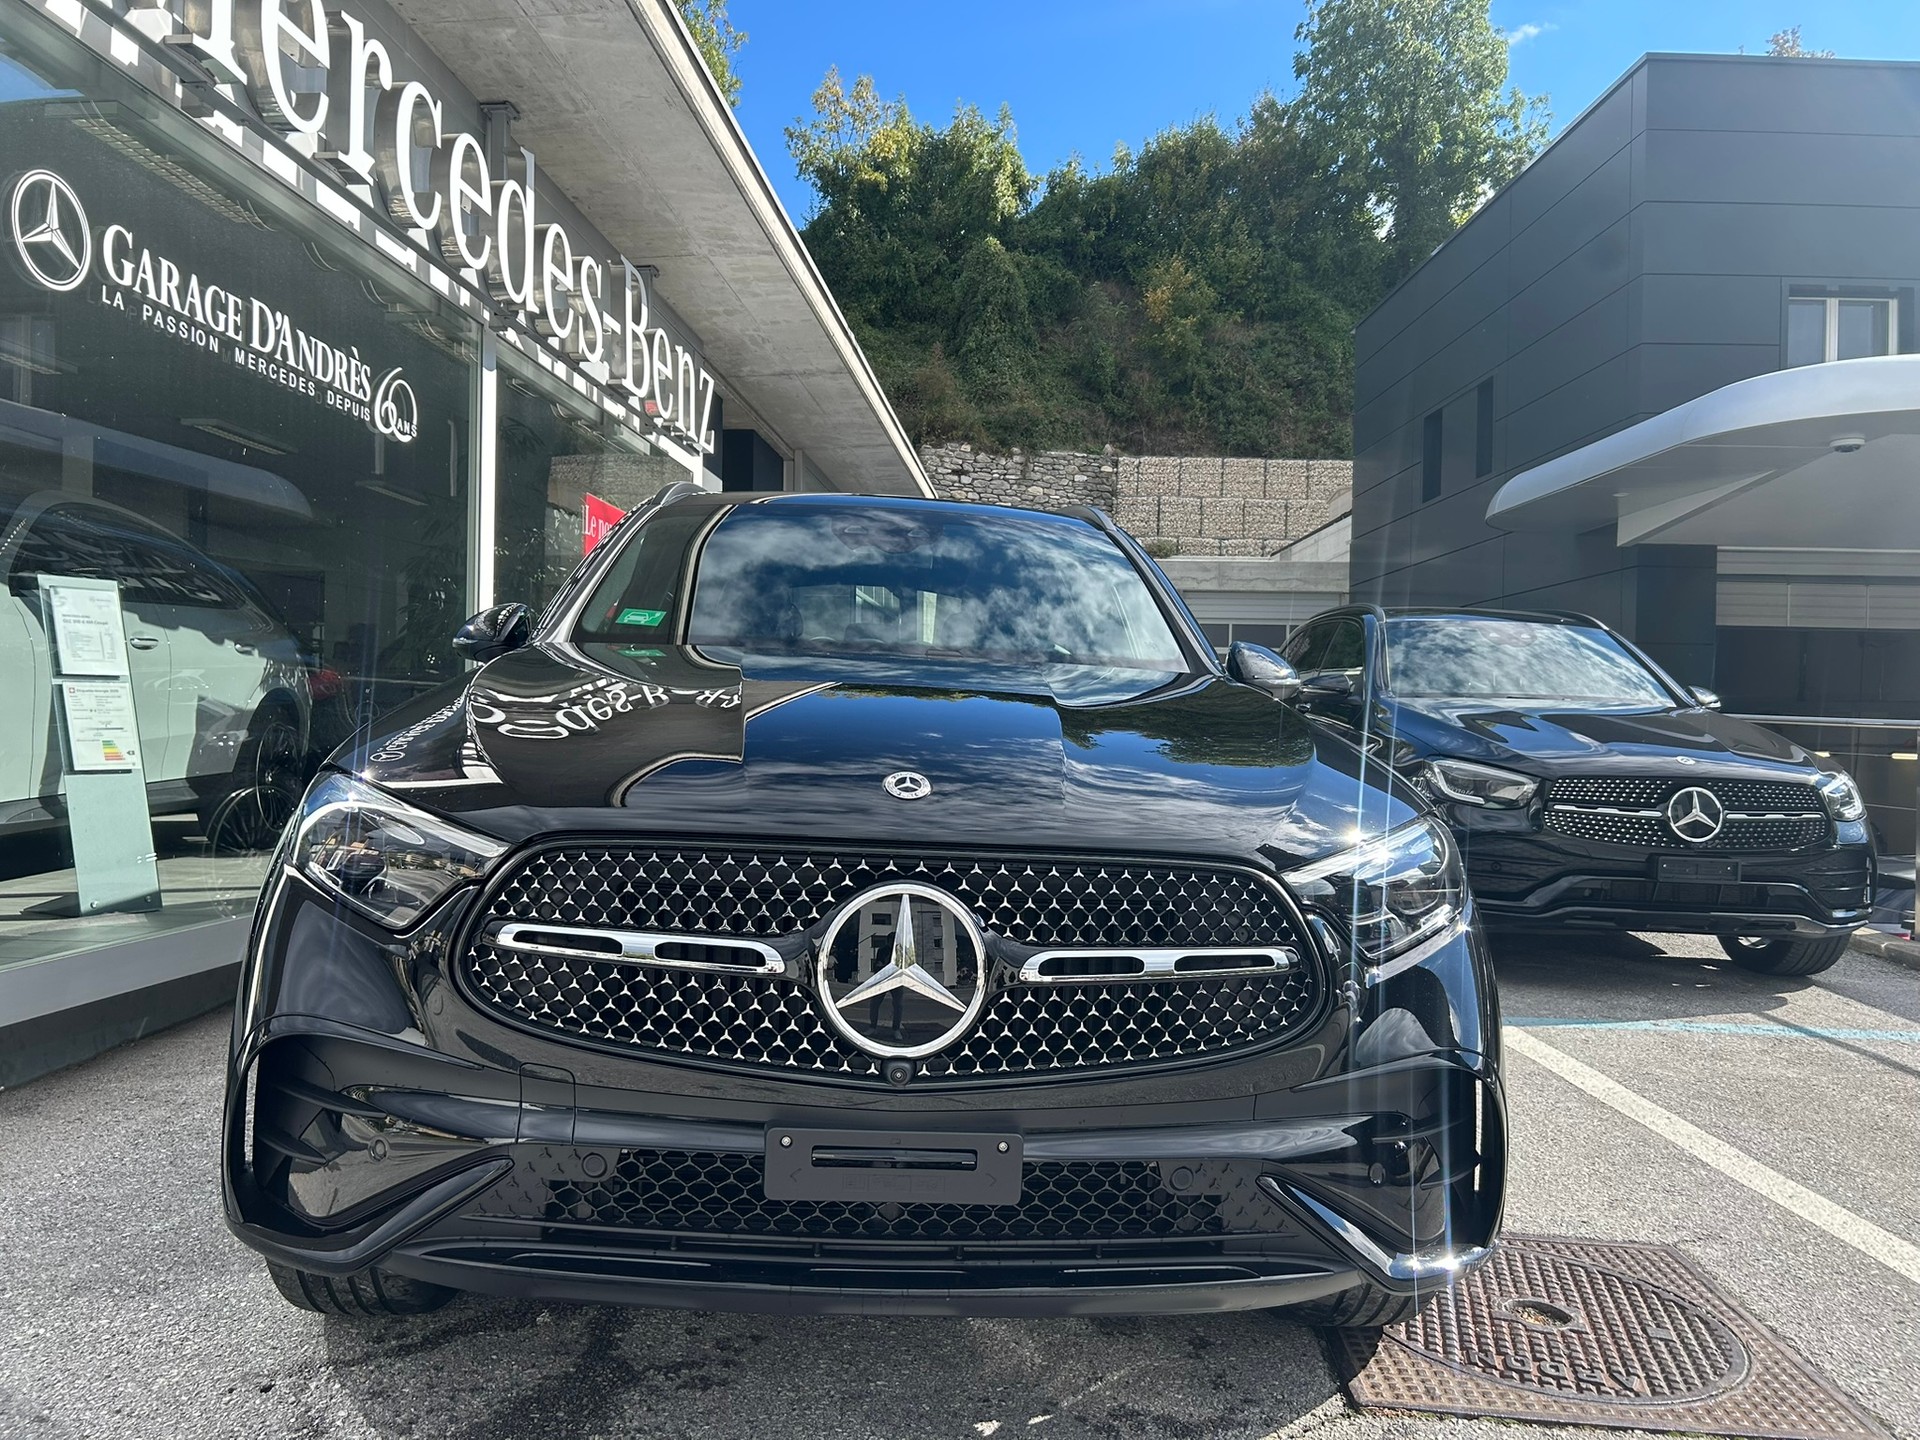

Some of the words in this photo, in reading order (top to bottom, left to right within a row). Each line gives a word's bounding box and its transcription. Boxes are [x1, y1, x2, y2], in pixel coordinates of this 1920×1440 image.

[102, 284, 125, 311] LA
[142, 304, 219, 352] PASSION
[235, 347, 316, 397] MERCEDES
[327, 390, 371, 422] DEPUIS
[397, 417, 418, 438] ANS
[103, 224, 243, 342] GARAGE
[250, 296, 371, 402] D'ANDRÈS
[585, 504, 597, 538] Le
